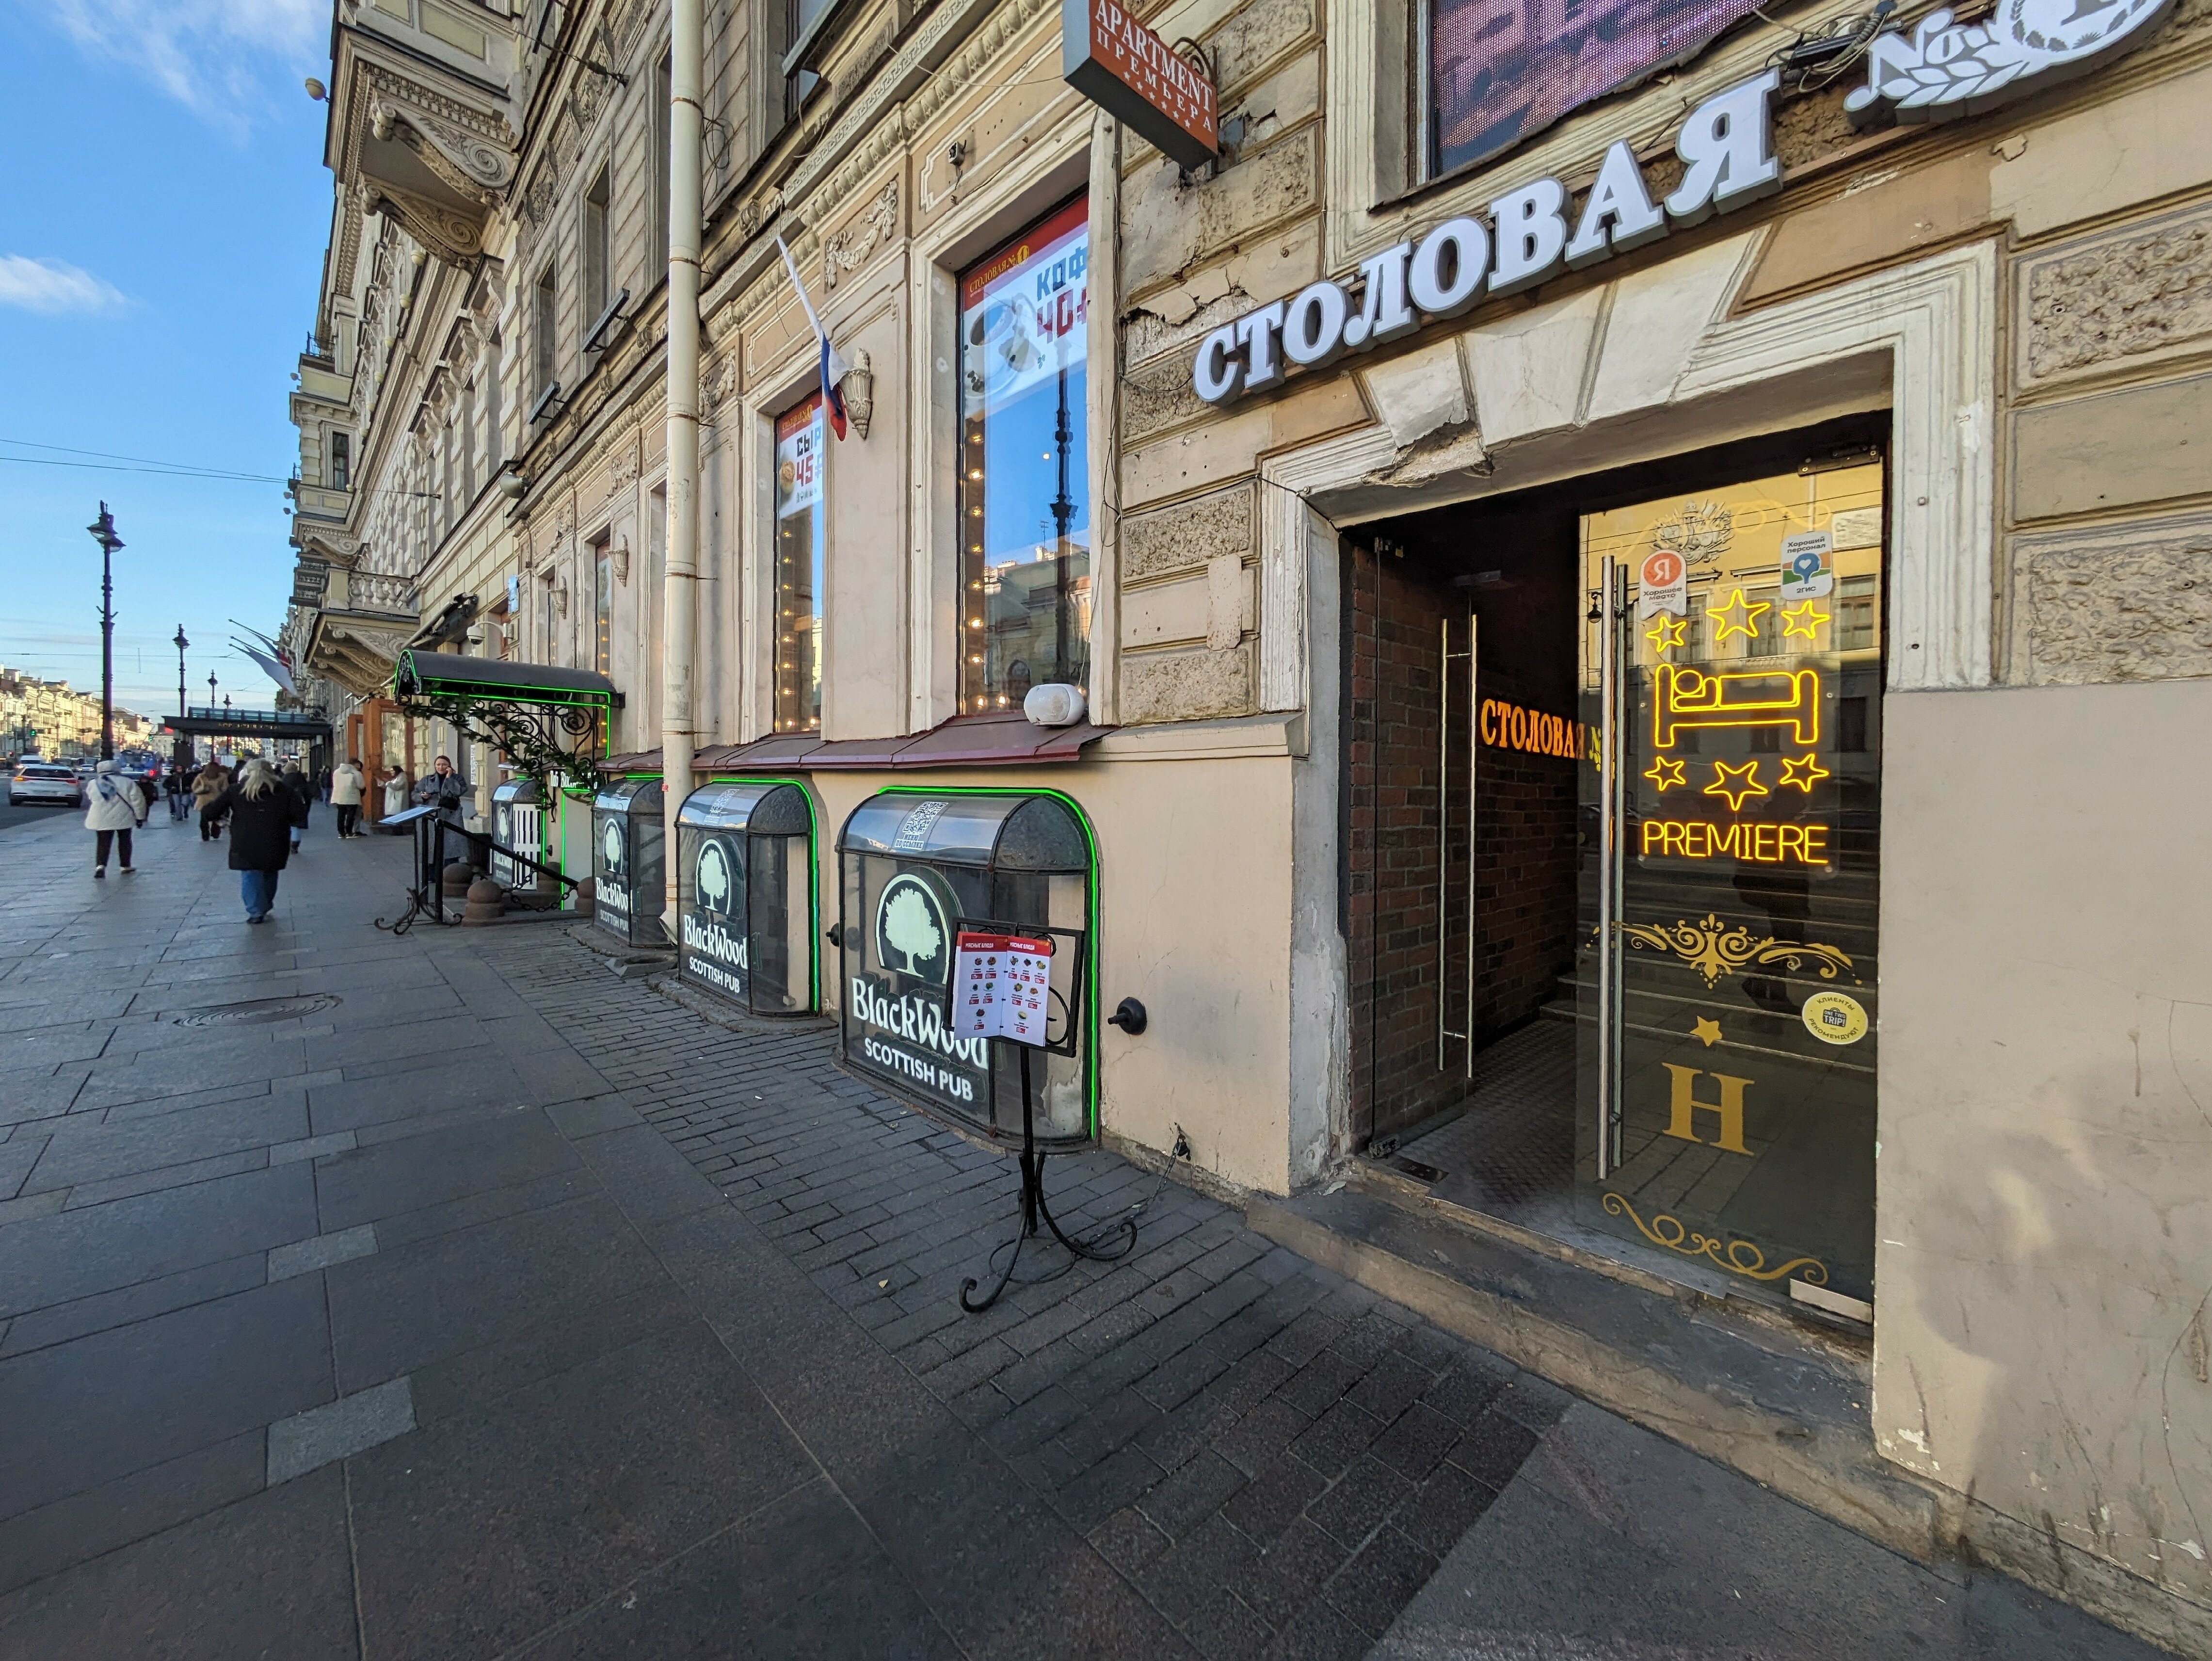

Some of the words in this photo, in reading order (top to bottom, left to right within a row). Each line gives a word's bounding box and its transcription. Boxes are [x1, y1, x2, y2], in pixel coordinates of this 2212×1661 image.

[1095, 0, 1212, 113] APARTMENT
[1096, 26, 1212, 132] ПРЕМЬЕРА
[1193, 68, 1782, 405] СТОЛОВАЯ
[969, 259, 1007, 292] СТОЛОВАЯ
[797, 425, 821, 457] СЫР
[1787, 536, 1825, 548] Хороший
[1787, 543, 1826, 553] персонал
[1643, 587, 1682, 597] Хорошее
[1643, 821, 1829, 864] PREMIERE
[684, 914, 748, 969] BlackWood
[689, 956, 723, 986] SCOTTISH
[724, 973, 740, 993] PUB
[1817, 997, 1855, 1011] КЛИЕНТЫ
[1809, 1018, 1859, 1040] РЕКОМЕНДУЮТ
[1824, 1015, 1845, 1027] TRIP!
[865, 1037, 935, 1086] SCOTTISH
[939, 1070, 973, 1101] PUB
